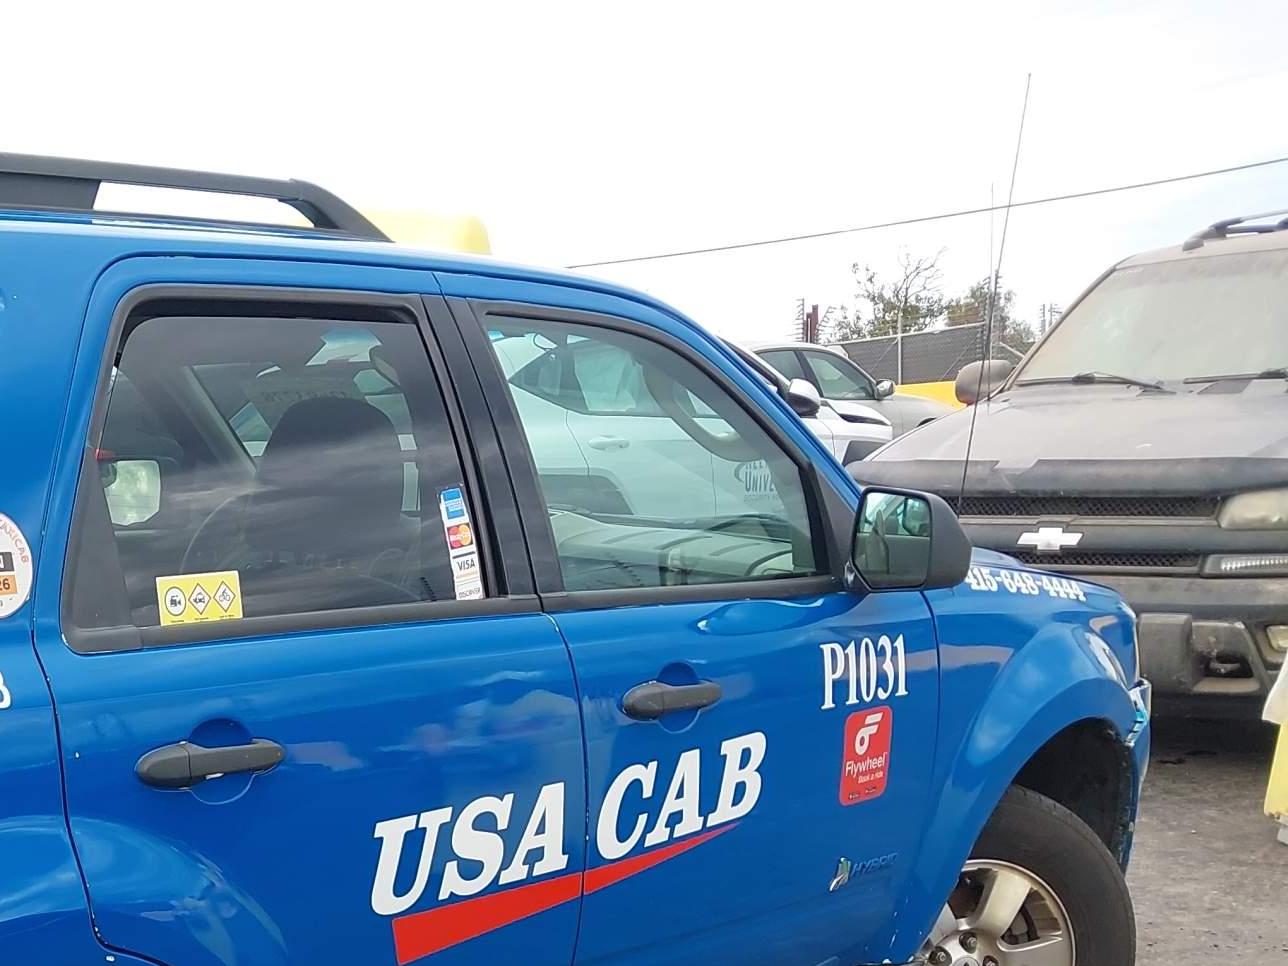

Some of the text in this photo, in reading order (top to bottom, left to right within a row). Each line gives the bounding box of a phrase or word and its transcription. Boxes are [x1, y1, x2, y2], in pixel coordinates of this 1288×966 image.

[745, 471, 775, 492] UNIV
[456, 558, 476, 572] VISA
[820, 633, 908, 710] P1031
[845, 752, 886, 779] Flywheel
[371, 731, 768, 916] USA CAB
